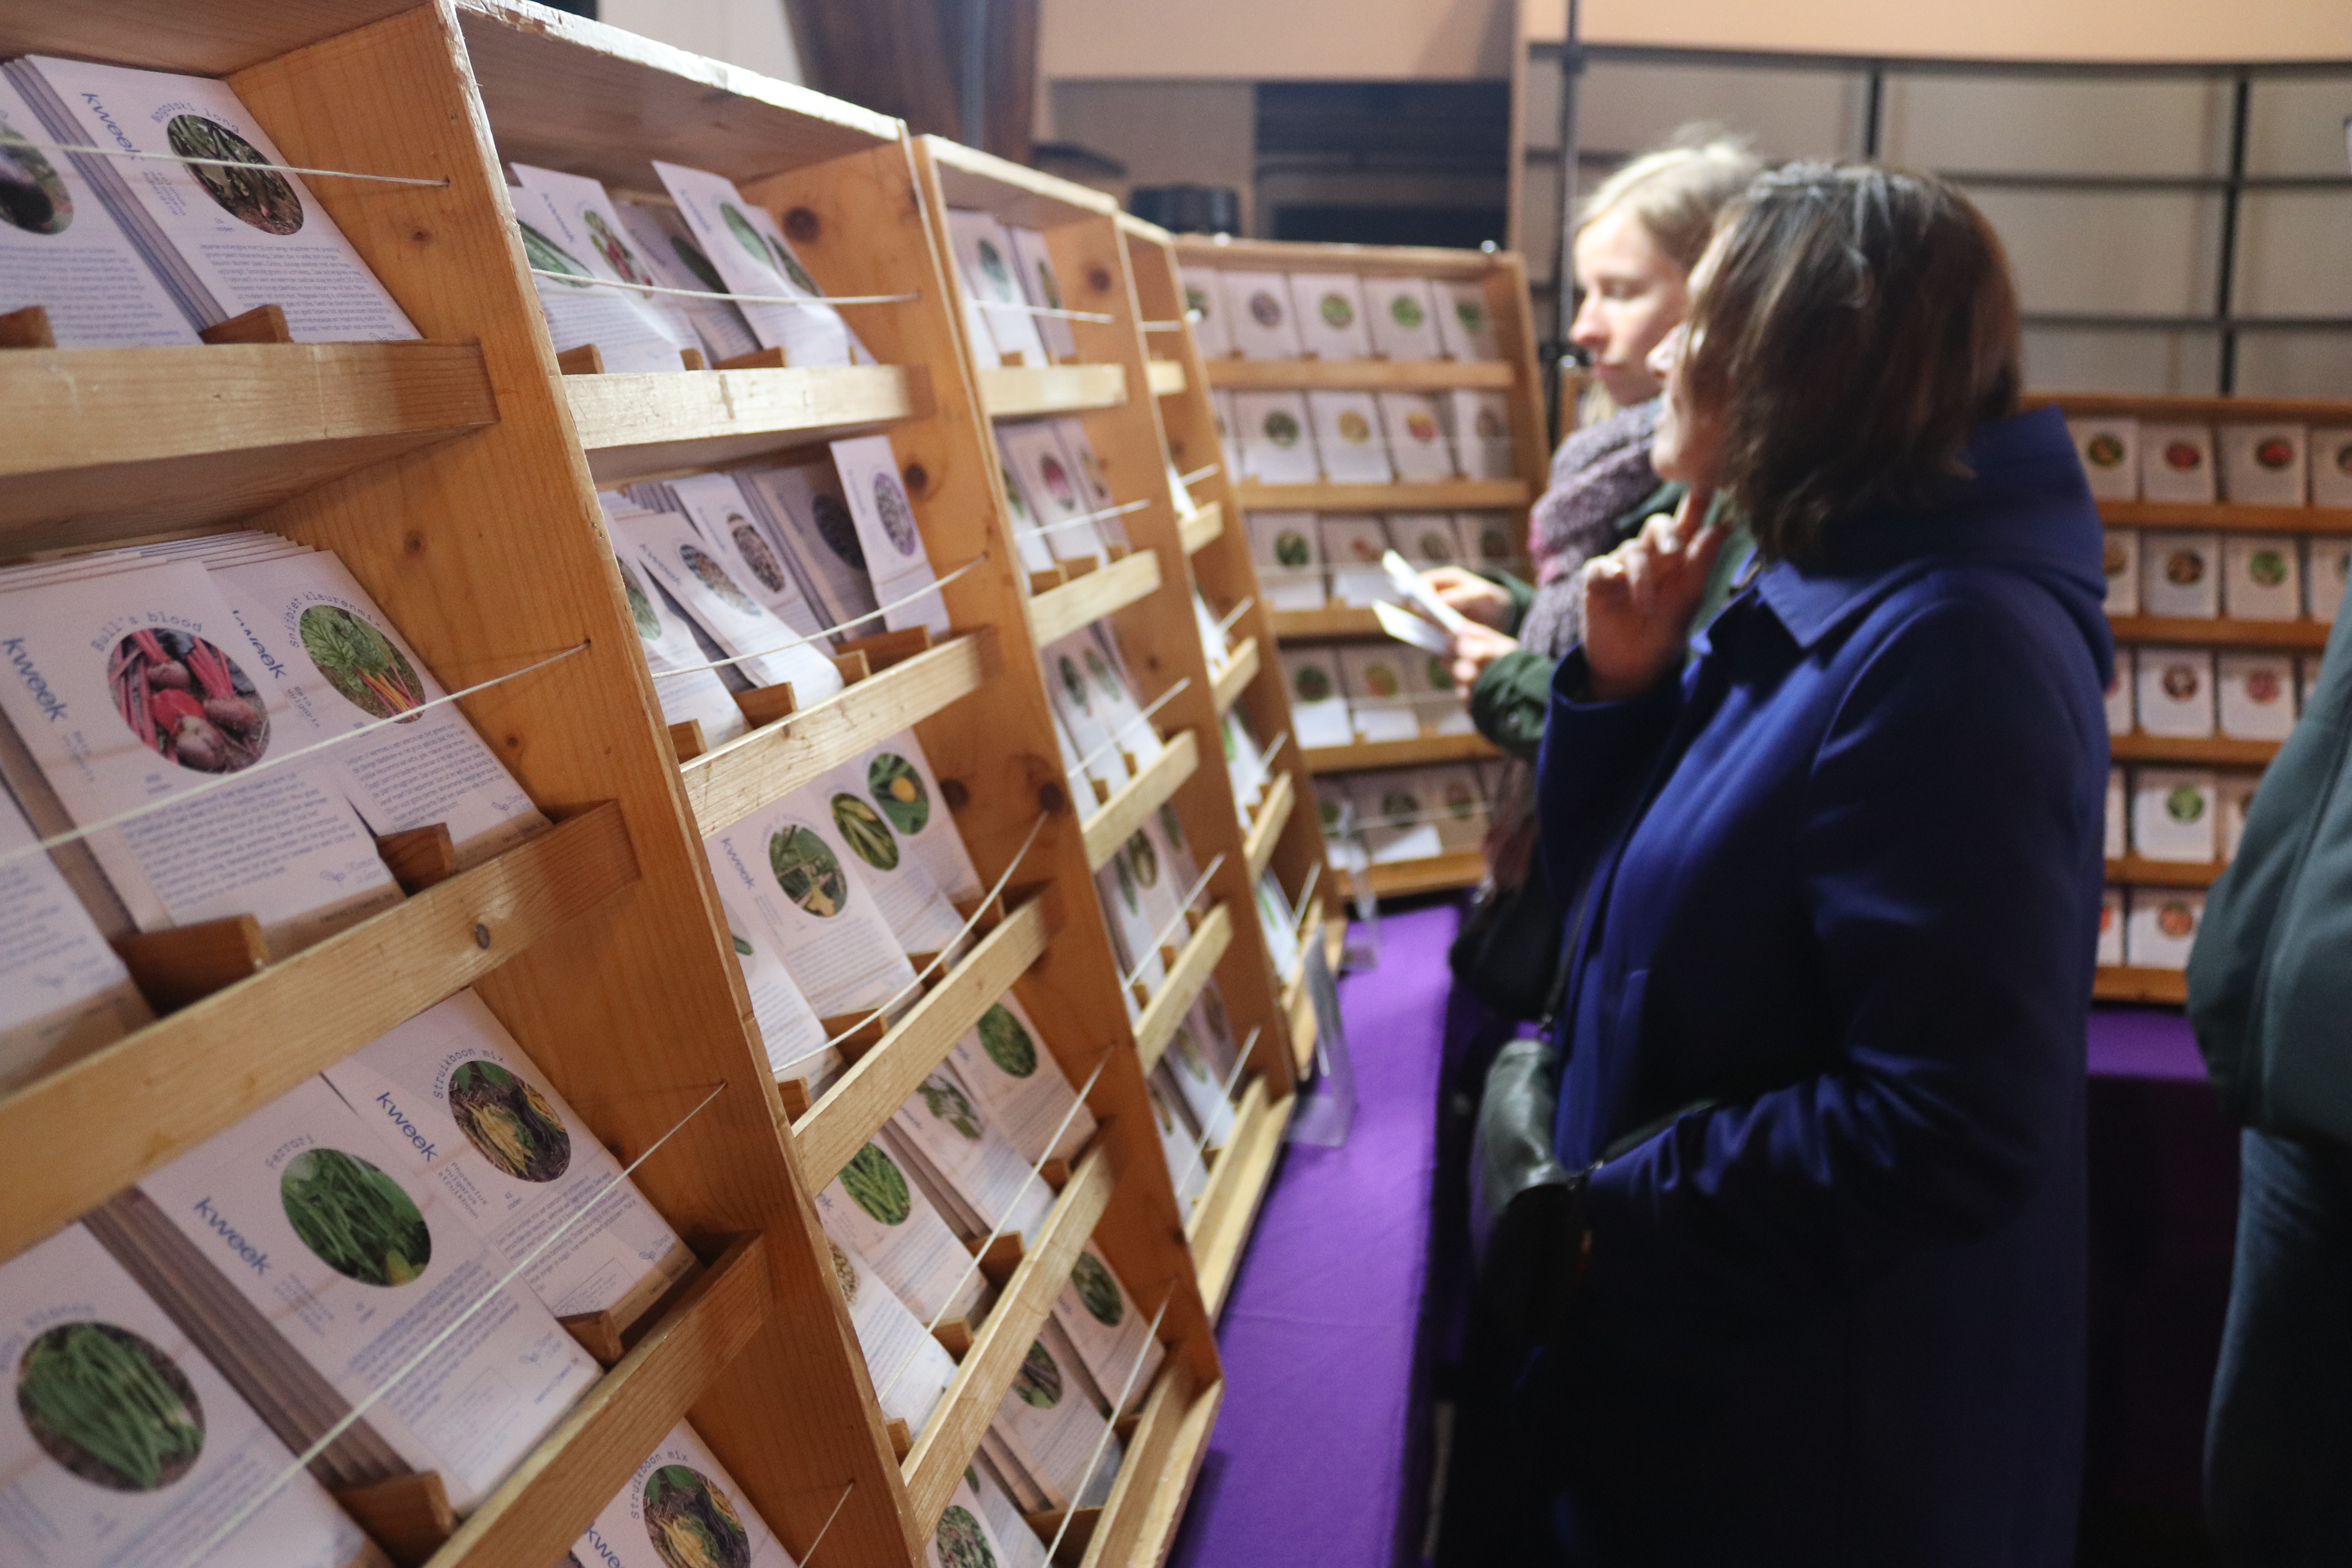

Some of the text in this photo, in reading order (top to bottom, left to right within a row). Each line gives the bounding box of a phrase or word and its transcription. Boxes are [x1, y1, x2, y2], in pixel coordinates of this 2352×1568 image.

[81, 93, 145, 160] kweek
[203, 107, 240, 133] long
[302, 592, 381, 627] kleurenmix
[2, 637, 67, 722] kweek
[482, 1049, 504, 1062] mix
[376, 1092, 437, 1162] kweek
[193, 1196, 272, 1276] kweek
[667, 1450, 688, 1462] mix
